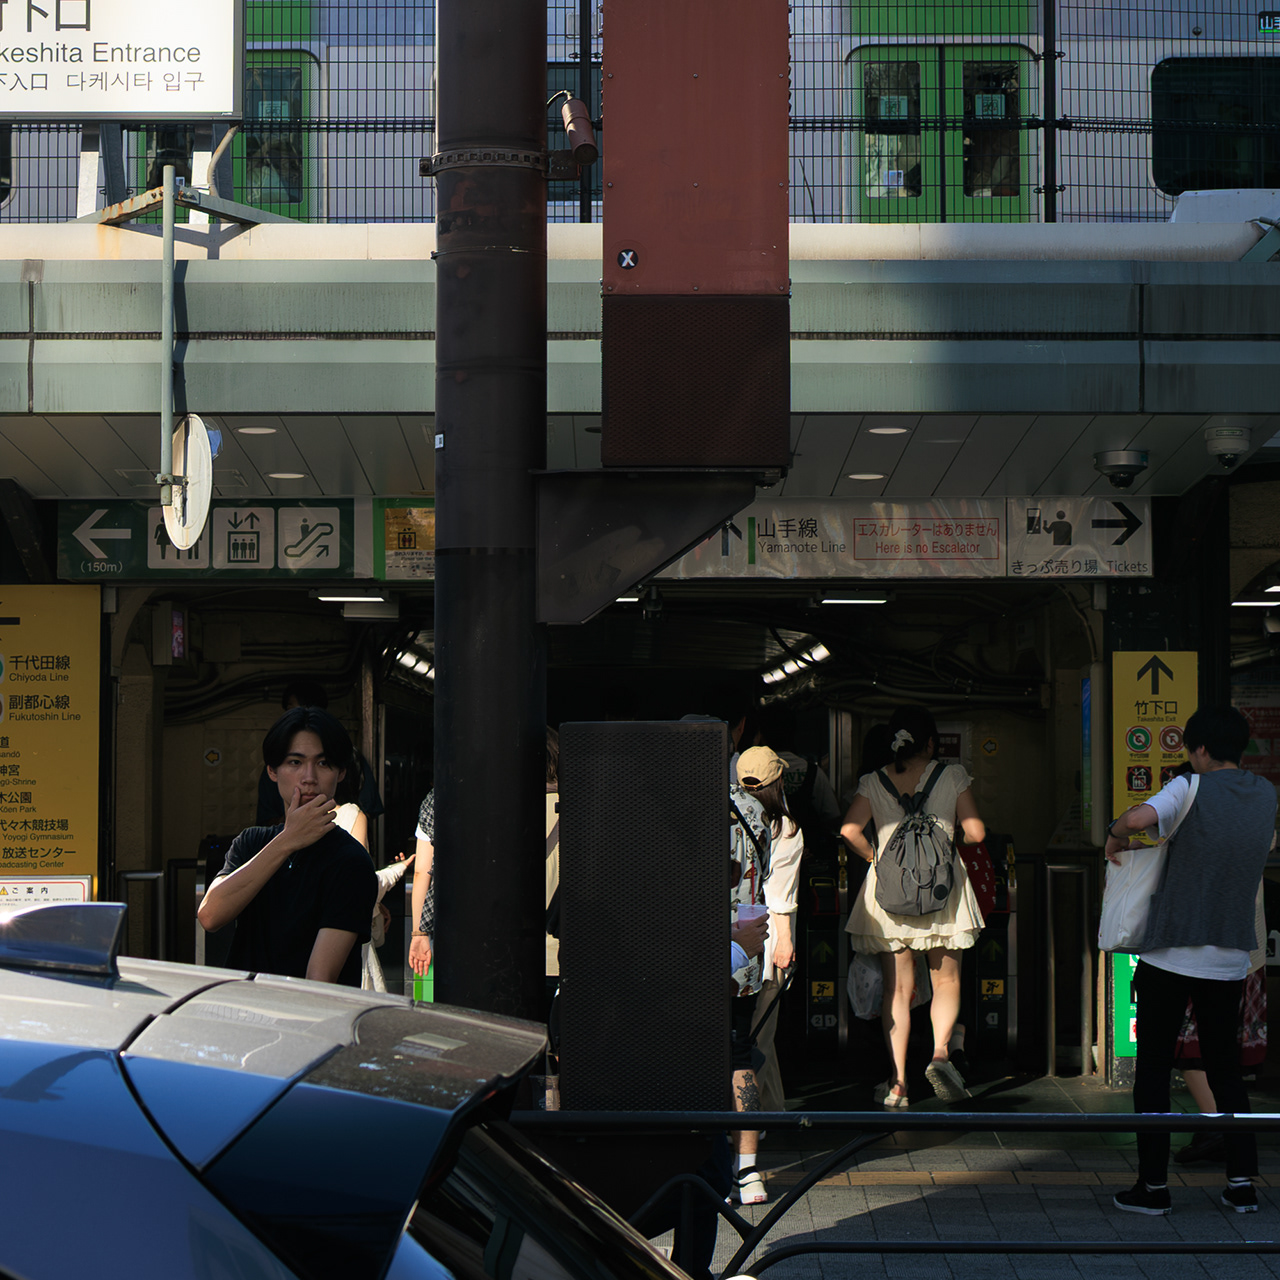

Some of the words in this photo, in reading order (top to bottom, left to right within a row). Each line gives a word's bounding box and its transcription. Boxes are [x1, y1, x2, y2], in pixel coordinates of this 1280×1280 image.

[93, 42, 201, 63] Entrance
[66, 71, 154, 92] 다케시타
[163, 71, 205, 92] 입구
[756, 519, 818, 539] 山手線
[857, 522, 997, 537] エスカレーターはありません
[758, 541, 818, 554] Yamanote
[821, 541, 846, 554] Line
[875, 541, 901, 554] Here
[903, 541, 913, 554] is
[915, 543, 929, 554] no
[932, 541, 980, 554] Escalator
[1011, 559, 1098, 575] きっぷ売り場
[1106, 560, 1148, 573] Tickets
[9, 655, 71, 670] 千代田線
[9, 673, 47, 683] Chiyoda
[50, 673, 69, 681] Line
[8, 694, 70, 710] 副都心線
[1134, 700, 1178, 715] 竹下口
[9, 712, 59, 721] Fukutoshin
[62, 712, 81, 721] Line
[3, 834, 28, 842] Yoyogi
[30, 834, 74, 842] Gymnasium
[2, 847, 76, 859] 放送センター
